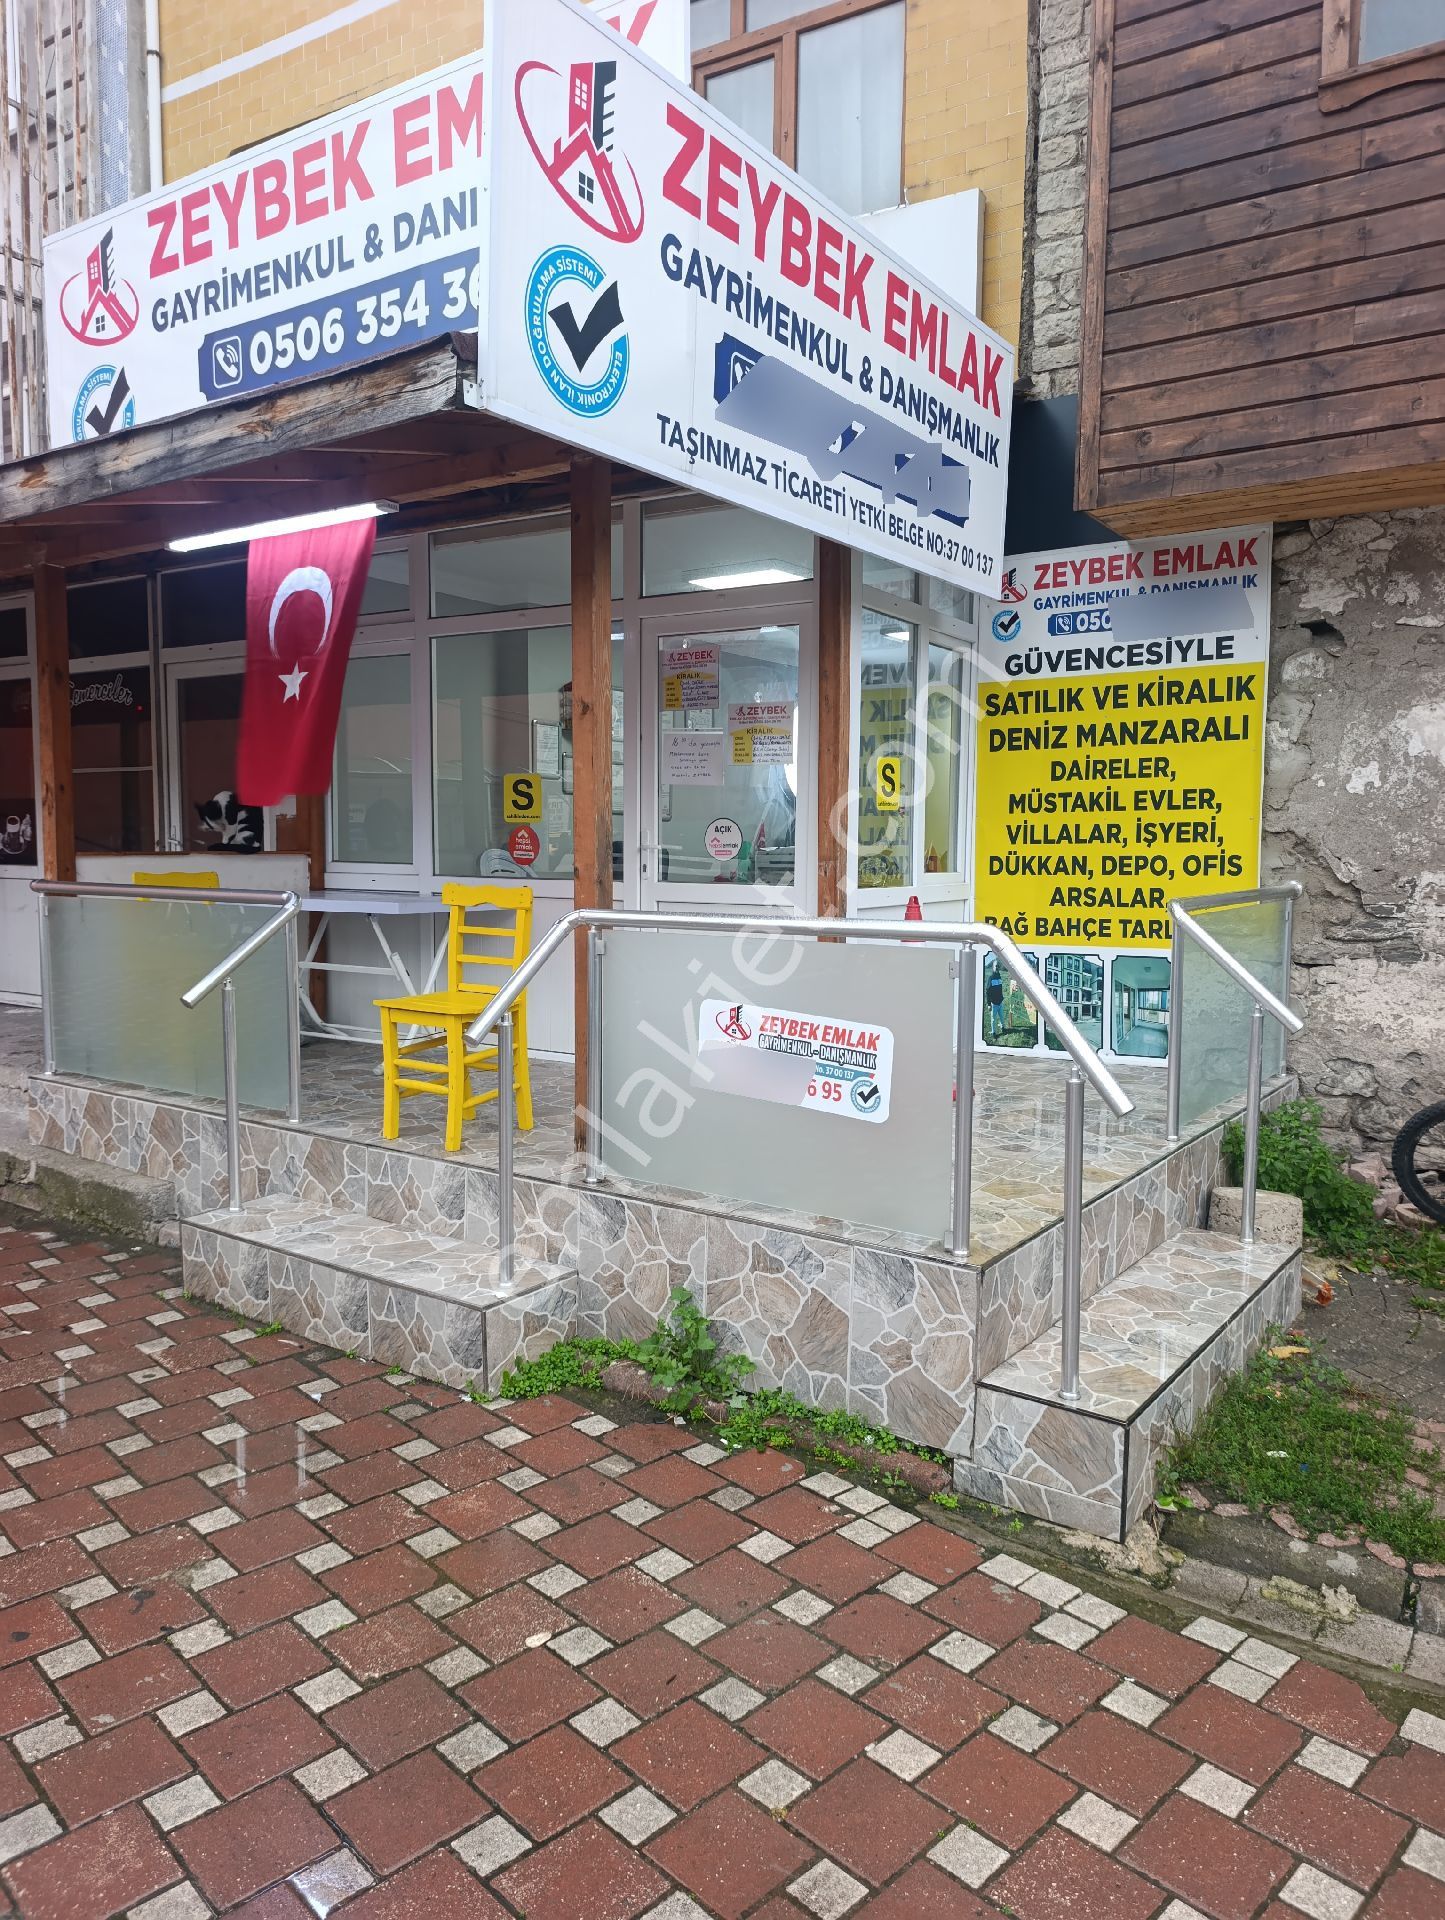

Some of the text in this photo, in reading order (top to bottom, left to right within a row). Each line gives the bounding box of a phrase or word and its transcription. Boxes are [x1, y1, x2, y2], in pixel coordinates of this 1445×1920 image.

[147, 120, 375, 279] ZEYBEK
[556, 255, 597, 285] SİSTEMİ
[662, 101, 1005, 418] ZEYBEK EMLAK
[151, 235, 355, 333] GAYRİMENKUL
[363, 223, 384, 262] &
[248, 306, 345, 375] 0506
[356, 276, 430, 345] 354
[532, 264, 557, 369] DOĞRULAMA
[660, 232, 1000, 469] GAYRİMENKUL & DANIŞMANLIK
[551, 369, 575, 403] İLAN
[657, 413, 994, 576] TAŞINMAZ TİCARETİ YETKİ BELGE NO:37 00 137
[1033, 537, 1259, 591] ZEYBEK EMLAK
[677, 650, 713, 661] ZEYBEK
[1004, 635, 1235, 677] GÜVENCESİYLE
[69, 674, 133, 707] emerciler
[985, 687, 1084, 717] SATILIK
[1092, 683, 1129, 710] VE
[1137, 674, 1256, 708] KİRALIK
[746, 705, 787, 716] ZEYBEK
[989, 714, 1249, 753] DENİZ MANZARALI
[881, 763, 896, 798] S
[1050, 755, 1176, 783] DAİRELER,
[512, 779, 534, 811] S
[1009, 785, 1222, 815] MÜSTAKİL EVLER,
[714, 825, 732, 835] AÇIK
[1006, 815, 1224, 848] VİLLALAR, İŞYERİ,
[989, 849, 1243, 880] DÜKKAN, DEPO, OFİS
[1035, 918, 1112, 942] BAHÇE
[1119, 918, 1173, 940] TARL
[759, 1014, 881, 1052] ZEYBEK EMLAK
[758, 1033, 814, 1058] GAYRİMENKUL
[819, 1044, 877, 1070] DANIŞMANLIK
[825, 1066, 834, 1076] 37
[833, 1068, 843, 1078] 00
[844, 1069, 855, 1080] 137
[821, 1080, 842, 1102] 95
